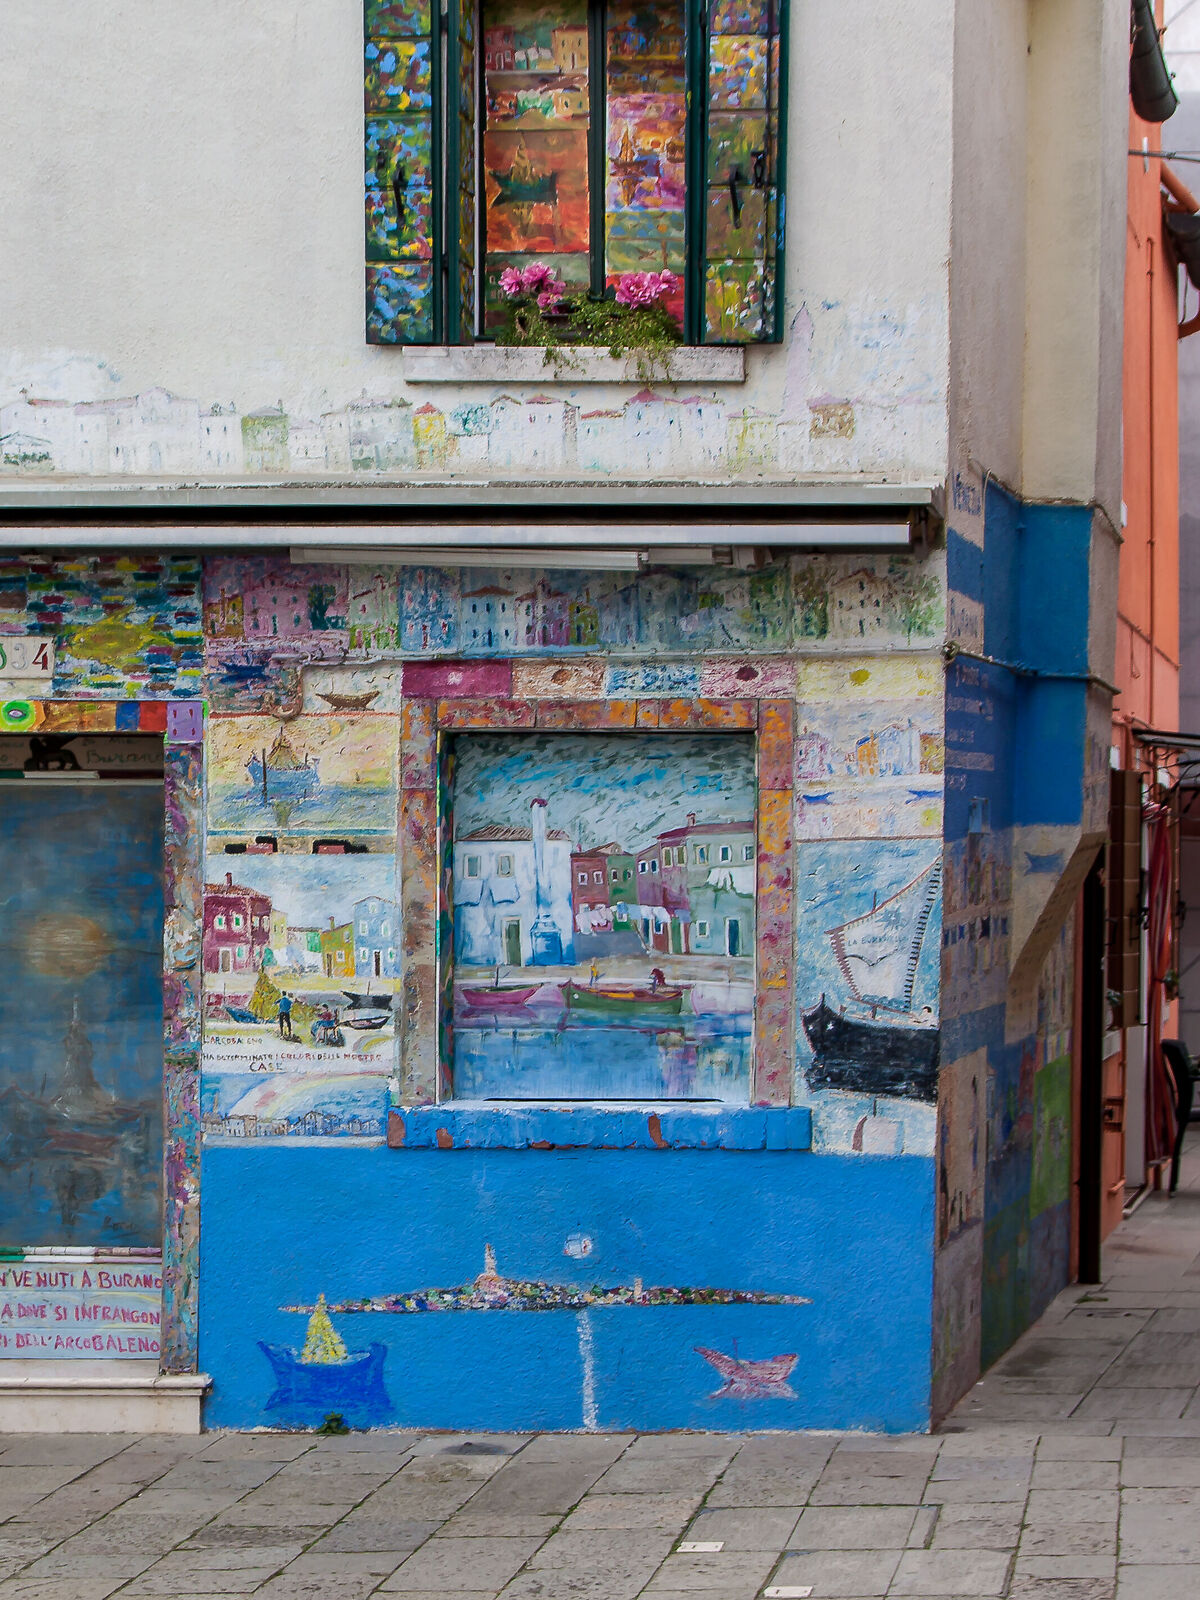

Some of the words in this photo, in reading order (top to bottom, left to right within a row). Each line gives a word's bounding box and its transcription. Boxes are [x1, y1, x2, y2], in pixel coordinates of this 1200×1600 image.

[249, 1061, 284, 1072] CASE
[81, 1268, 92, 1288] A
[98, 1271, 163, 1289] BURANO
[54, 1304, 68, 1321] SI
